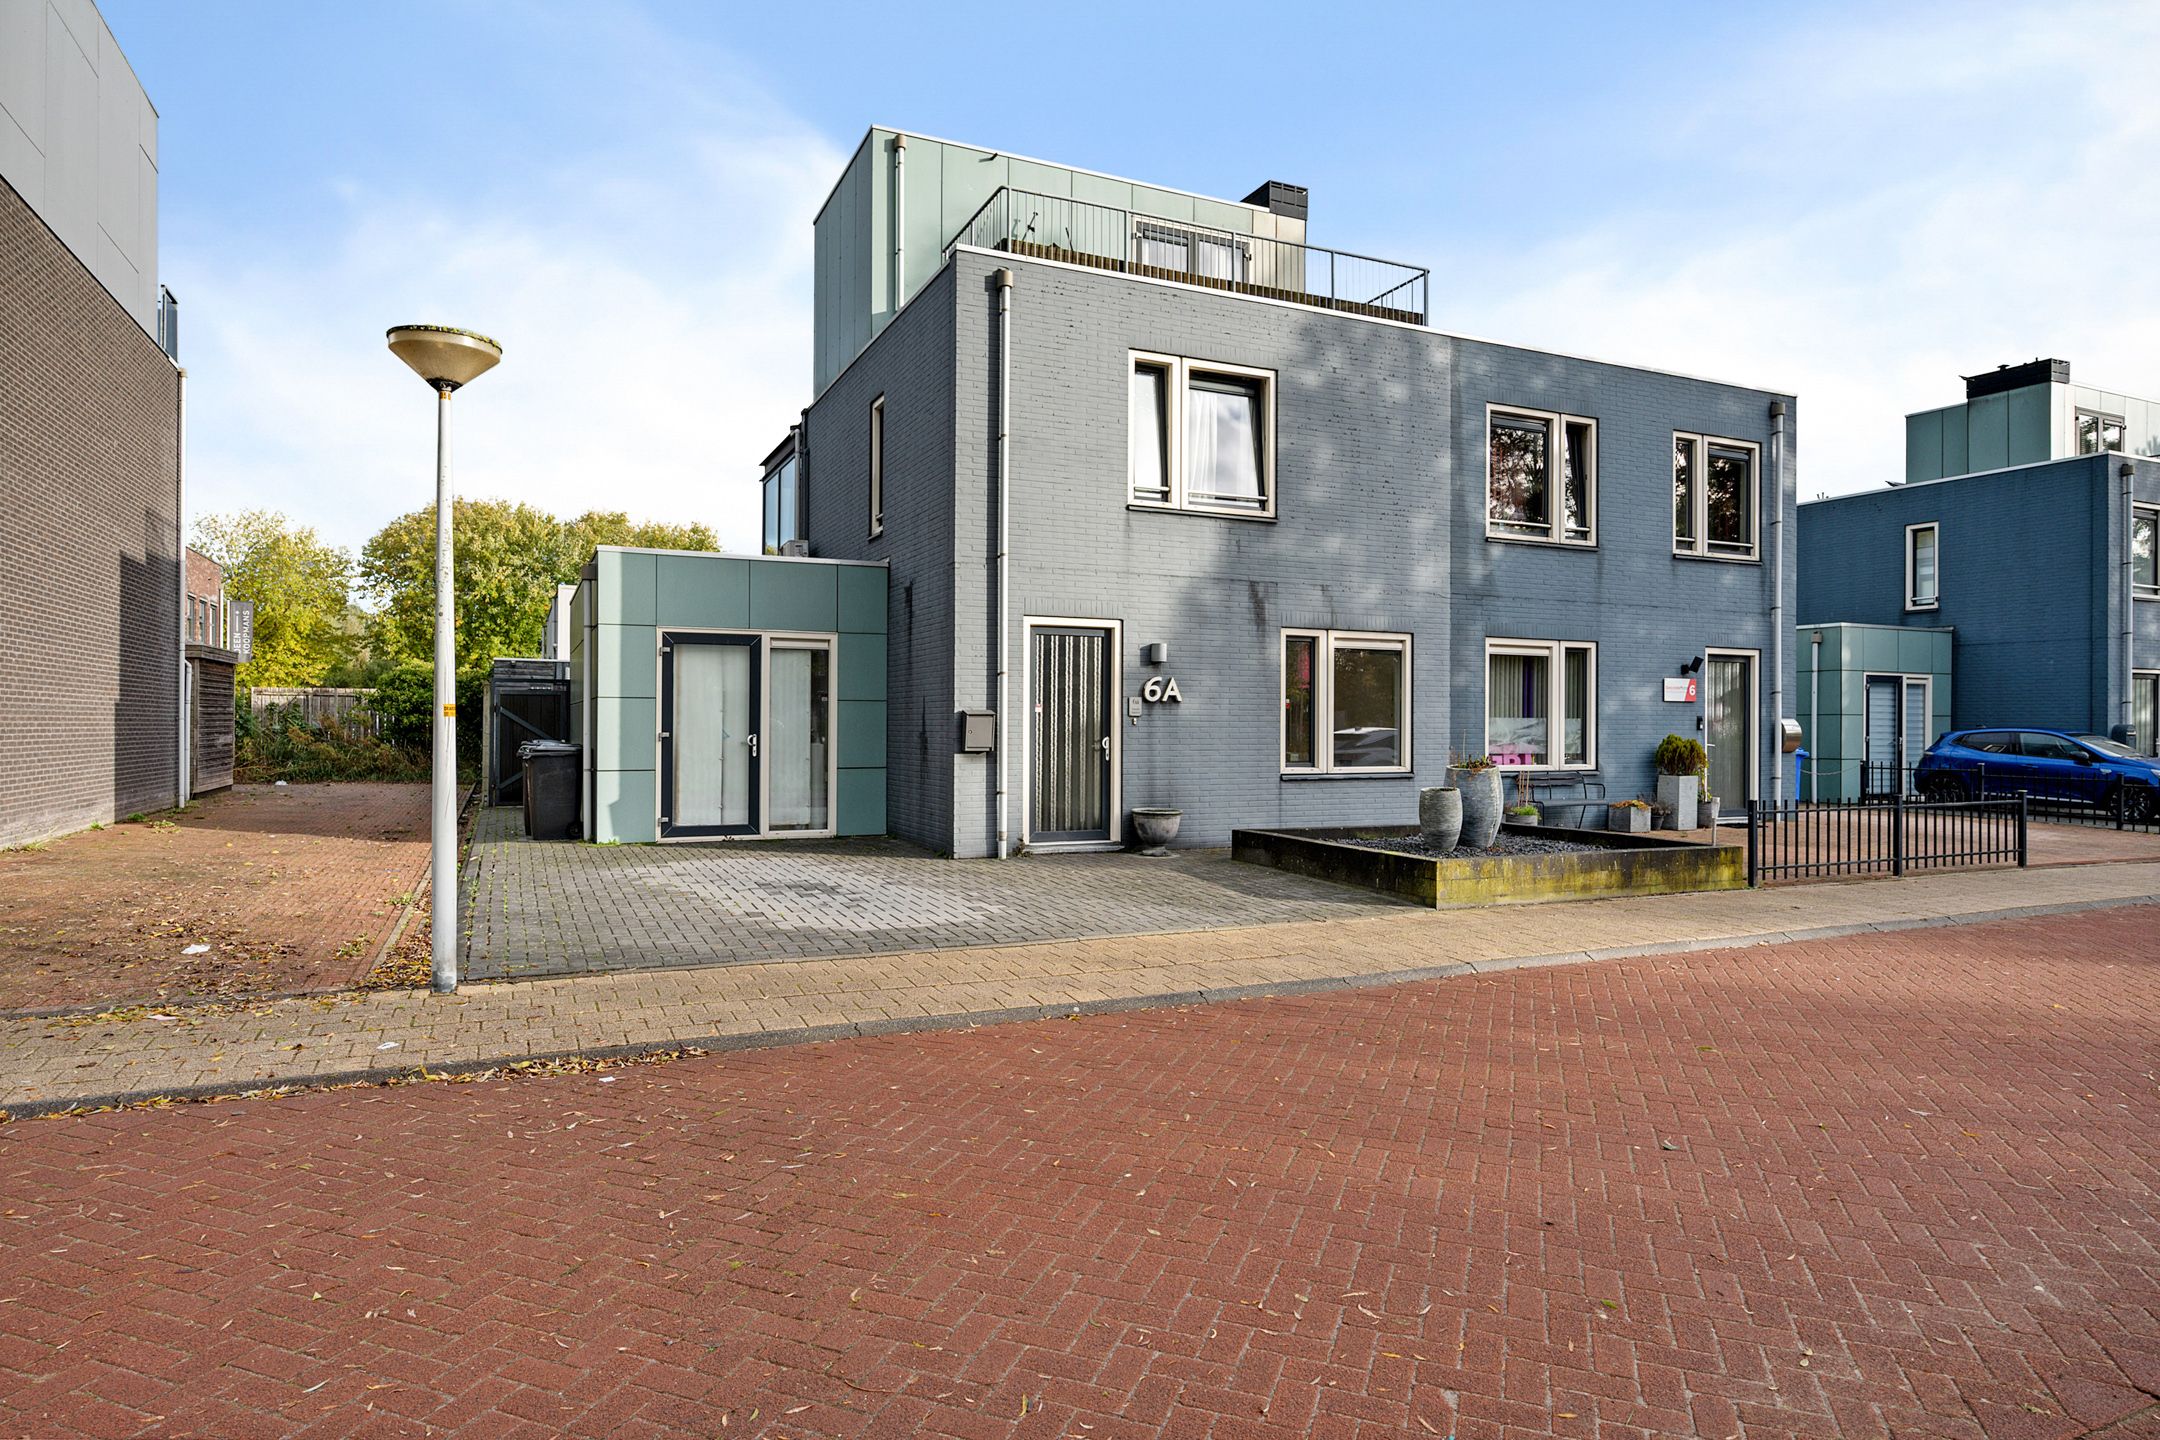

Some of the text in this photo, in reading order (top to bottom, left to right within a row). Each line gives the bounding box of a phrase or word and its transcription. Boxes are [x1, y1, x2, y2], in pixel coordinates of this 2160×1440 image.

[242, 610, 251, 655] KOOPMANS
[1144, 676, 1183, 702] 6A
[1689, 685, 1696, 696] 6
